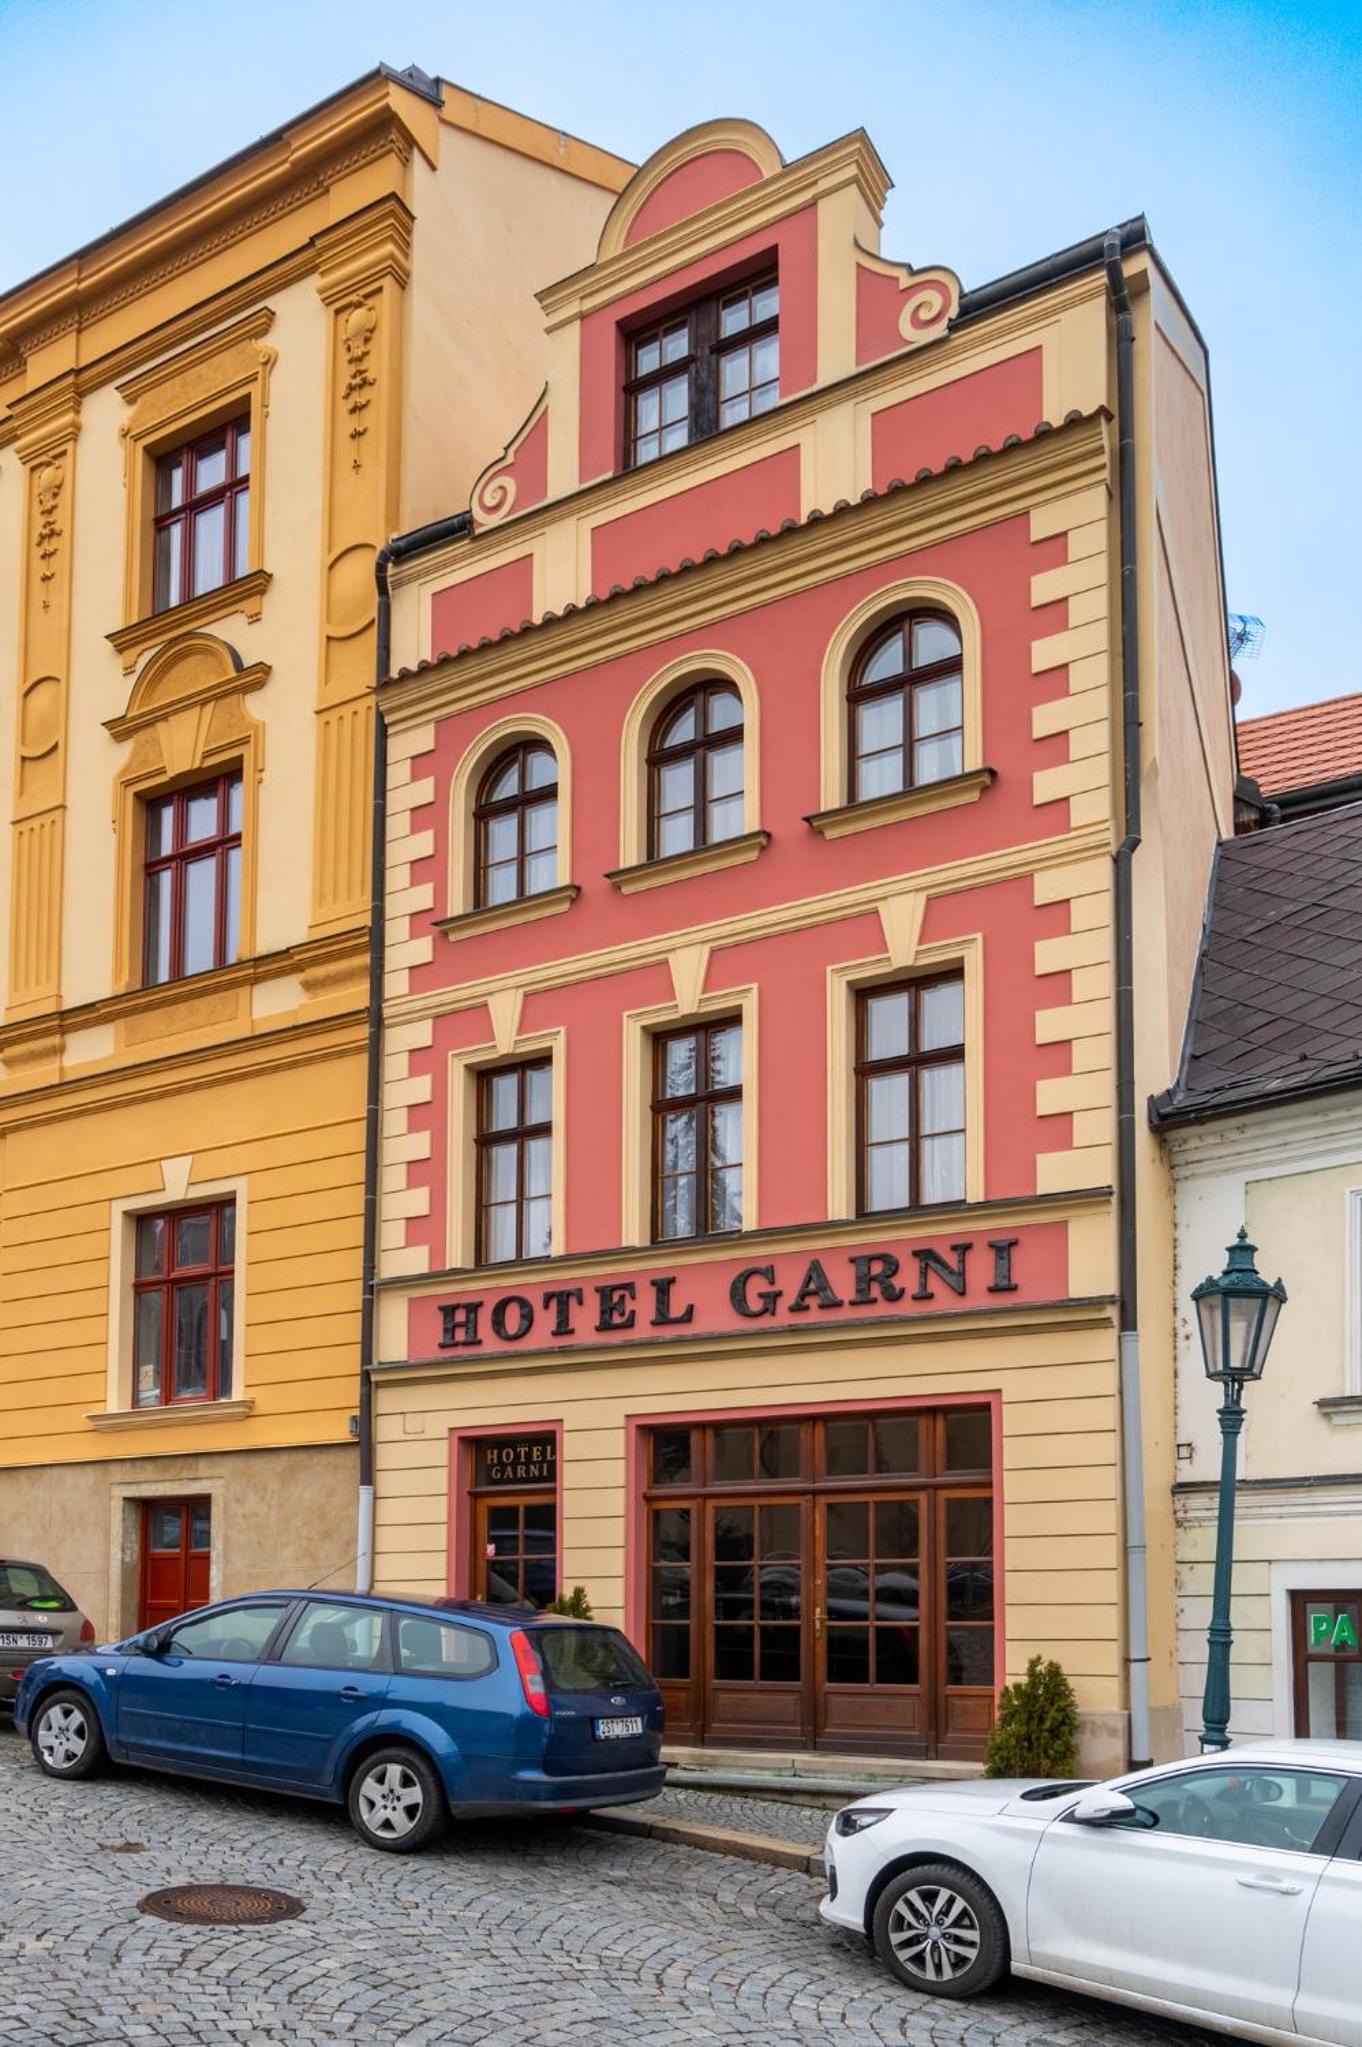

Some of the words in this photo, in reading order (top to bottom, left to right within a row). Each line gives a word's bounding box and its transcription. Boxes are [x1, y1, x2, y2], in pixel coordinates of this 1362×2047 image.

[438, 1276, 695, 1349] HOTEL
[729, 1238, 1018, 1318] GARNI
[486, 1446, 556, 1464] HOTEL
[491, 1463, 547, 1479] GARNI
[0, 1634, 18, 1646] 1SN
[26, 1635, 49, 1647] 1597
